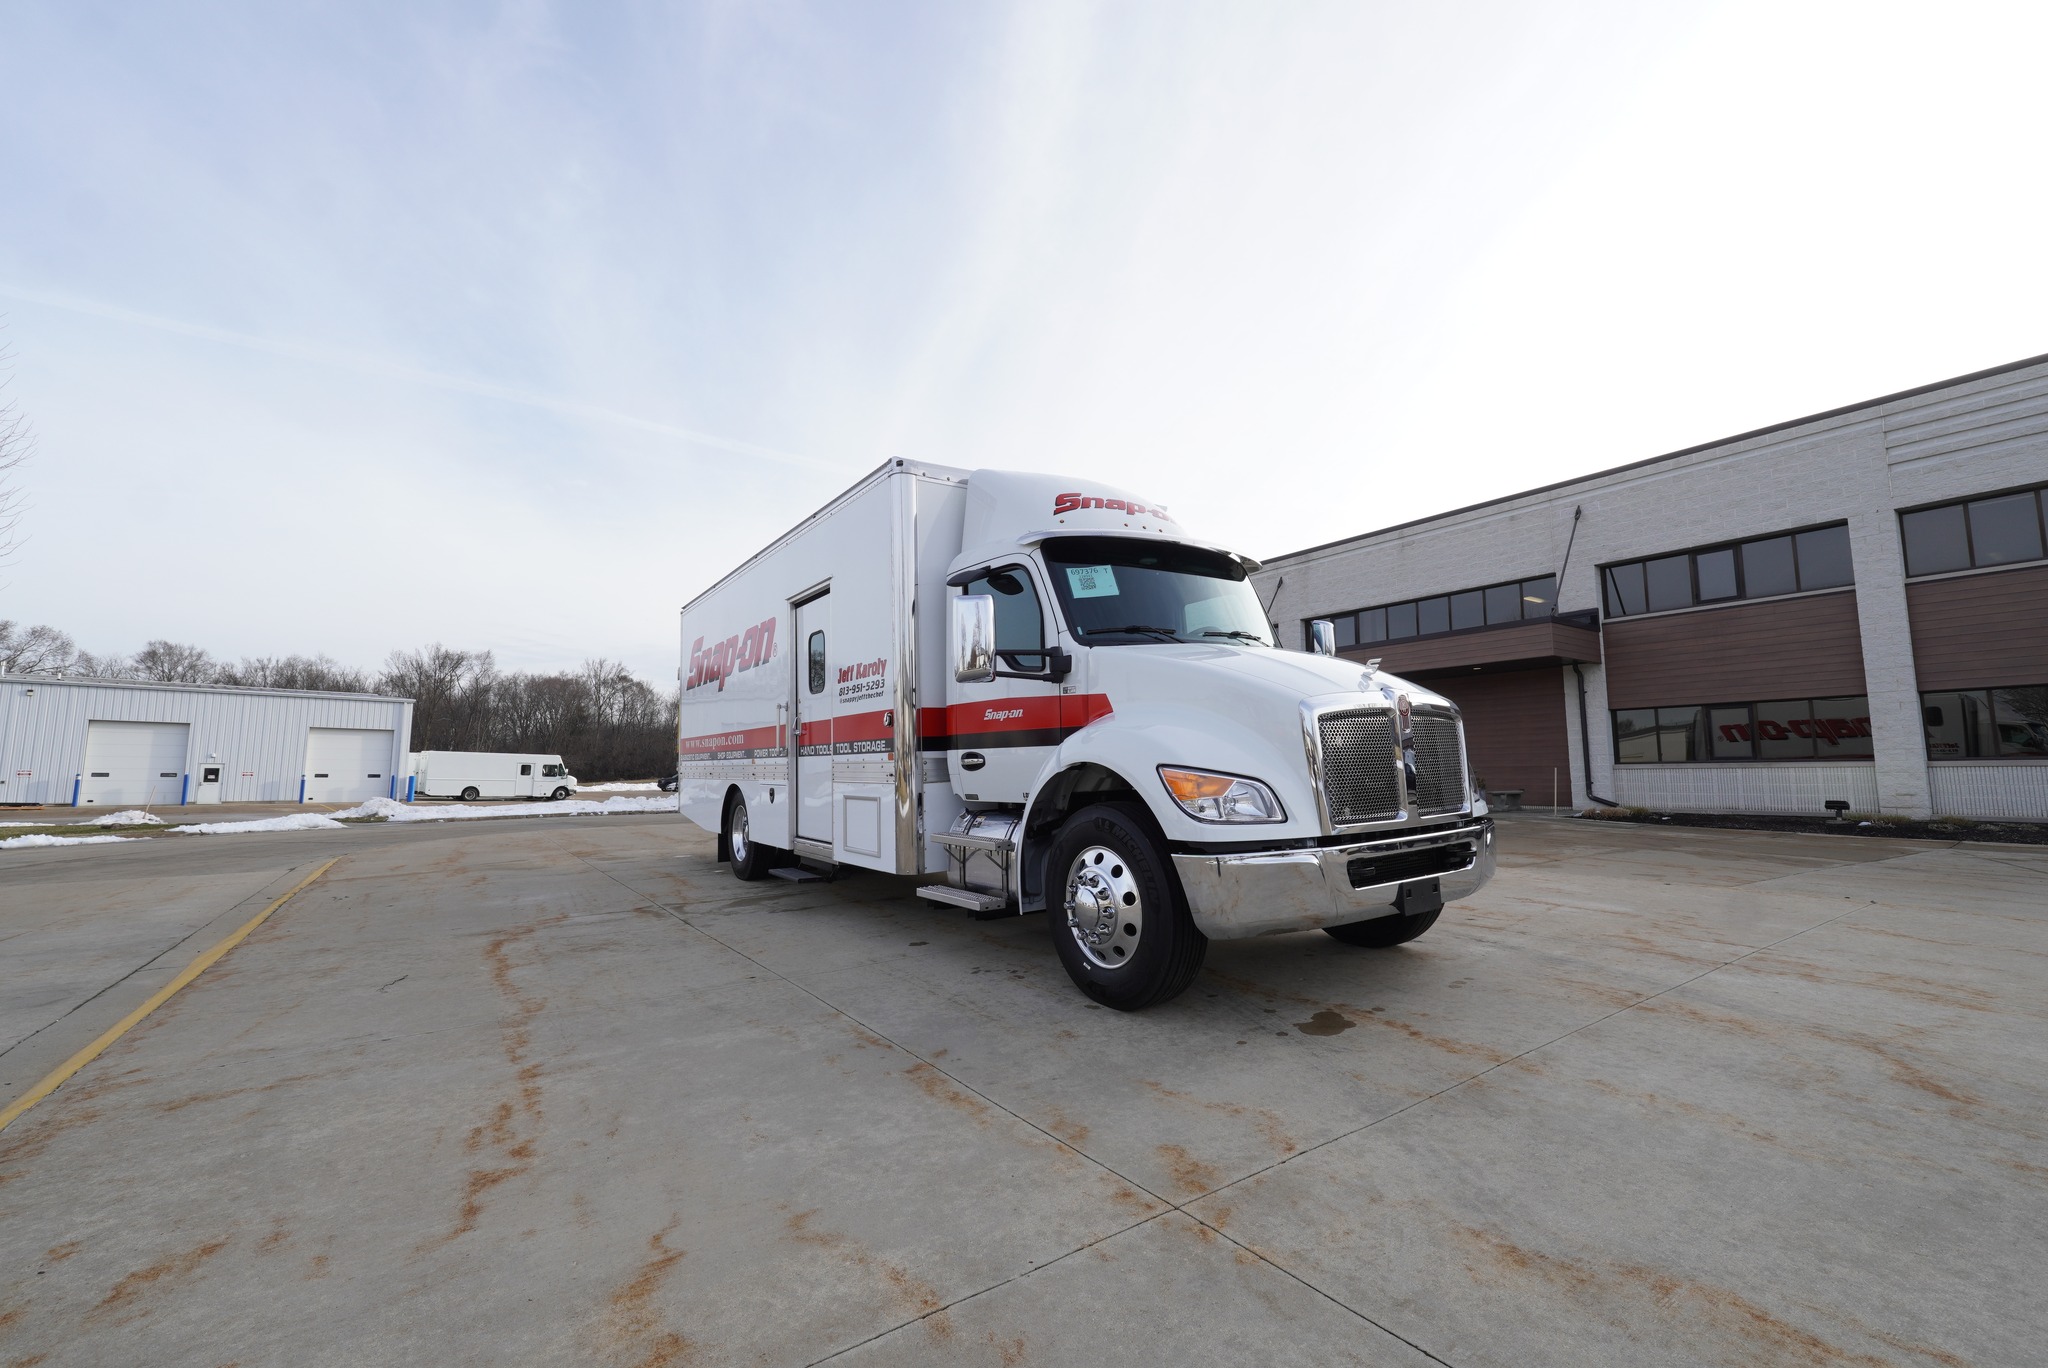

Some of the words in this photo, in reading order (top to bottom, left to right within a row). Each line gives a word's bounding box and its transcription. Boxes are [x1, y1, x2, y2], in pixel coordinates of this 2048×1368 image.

[1053, 492, 1174, 524] Snap-o
[838, 665, 855, 684] Jeff
[856, 657, 887, 680] Karoly
[839, 678, 886, 697] 813-951-5293
[983, 708, 1024, 722] Snap-on
[685, 734, 744, 749] www.snapon.com
[754, 748, 768, 757] POWER
[800, 746, 814, 755] HAND
[816, 744, 832, 754] TOOLS
[836, 743, 851, 754] TOOL
